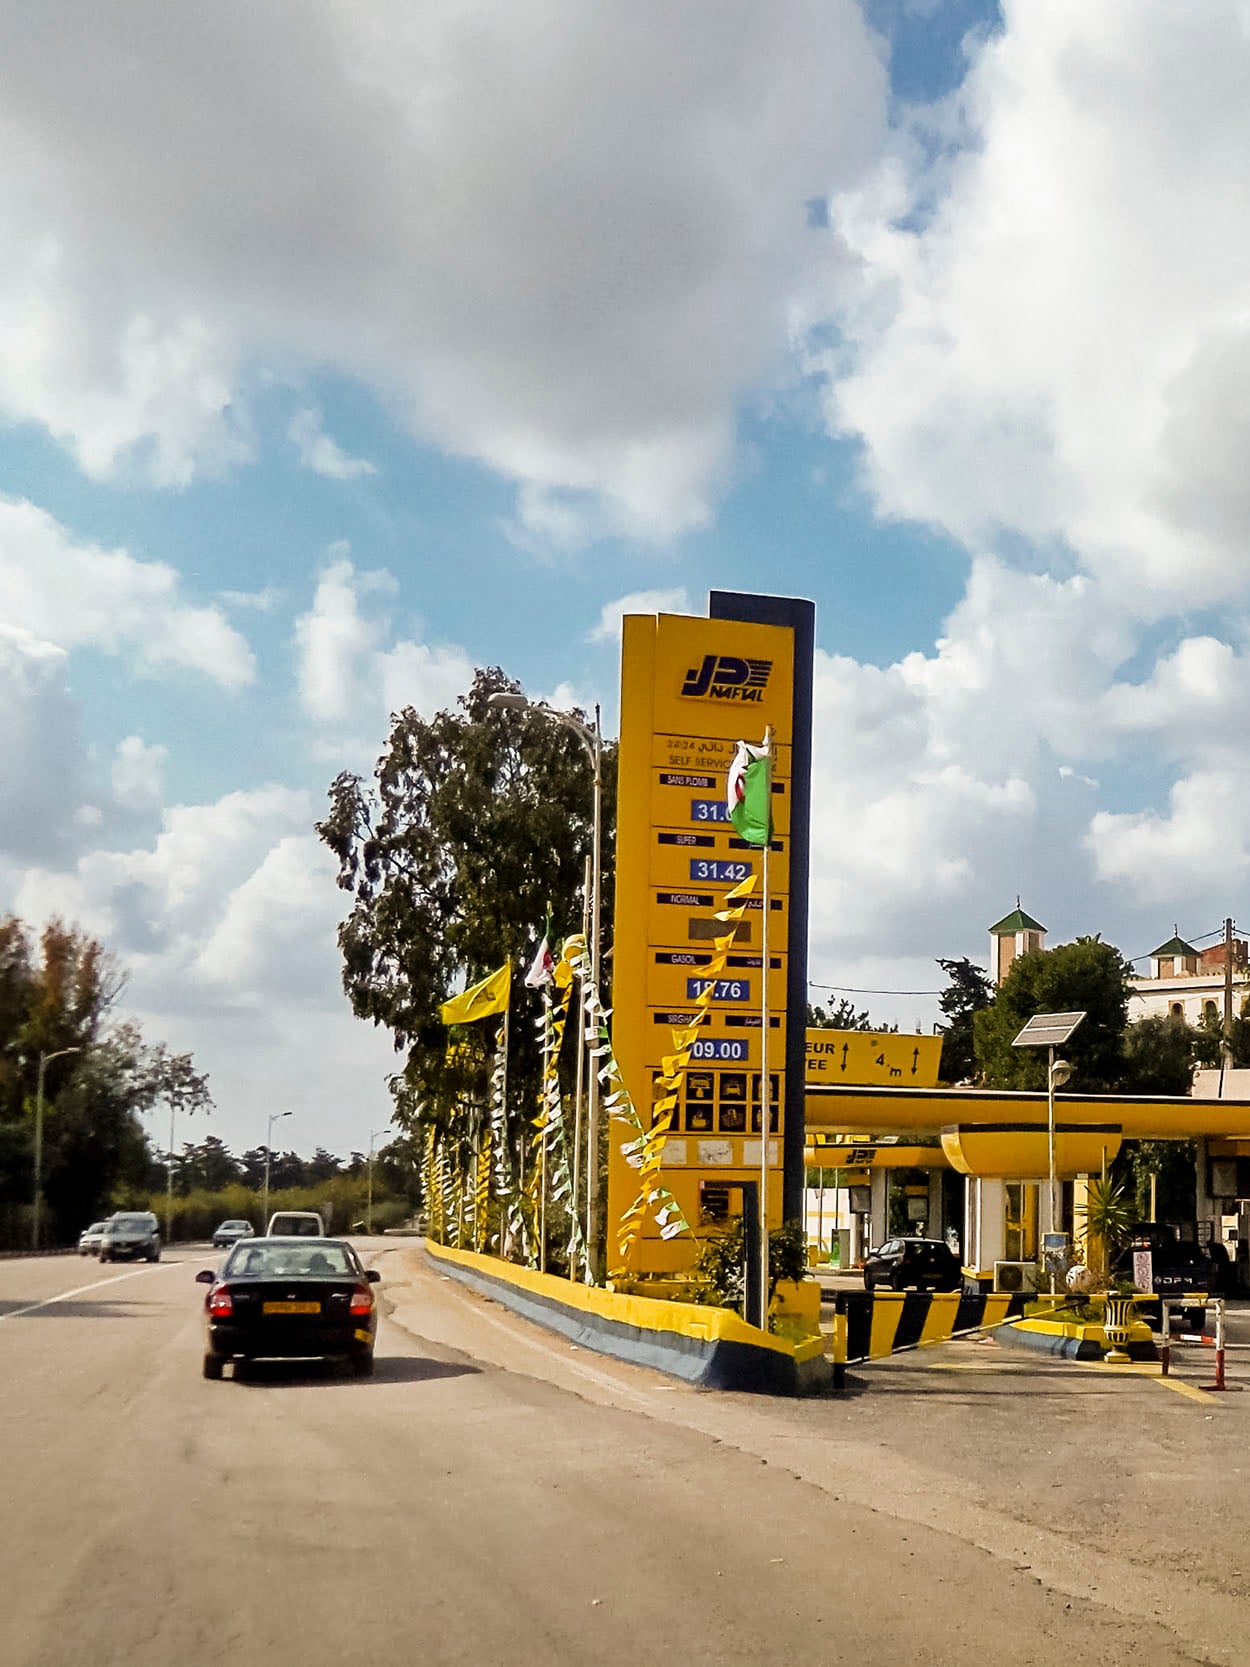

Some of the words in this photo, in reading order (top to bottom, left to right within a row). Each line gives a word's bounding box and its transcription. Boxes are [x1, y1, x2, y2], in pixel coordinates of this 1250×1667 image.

[709, 685, 764, 702] NAFTAL
[669, 755, 691, 766] SELF
[696, 757, 731, 769] SERVIC
[677, 835, 697, 845] SUPER
[698, 861, 746, 880] 31.42
[671, 894, 700, 905] NORMAL
[671, 954, 697, 965] GASOIL
[667, 1014, 698, 1024] SIRGHA
[693, 1041, 742, 1059] 09.00
[805, 1059, 827, 1070] EE
